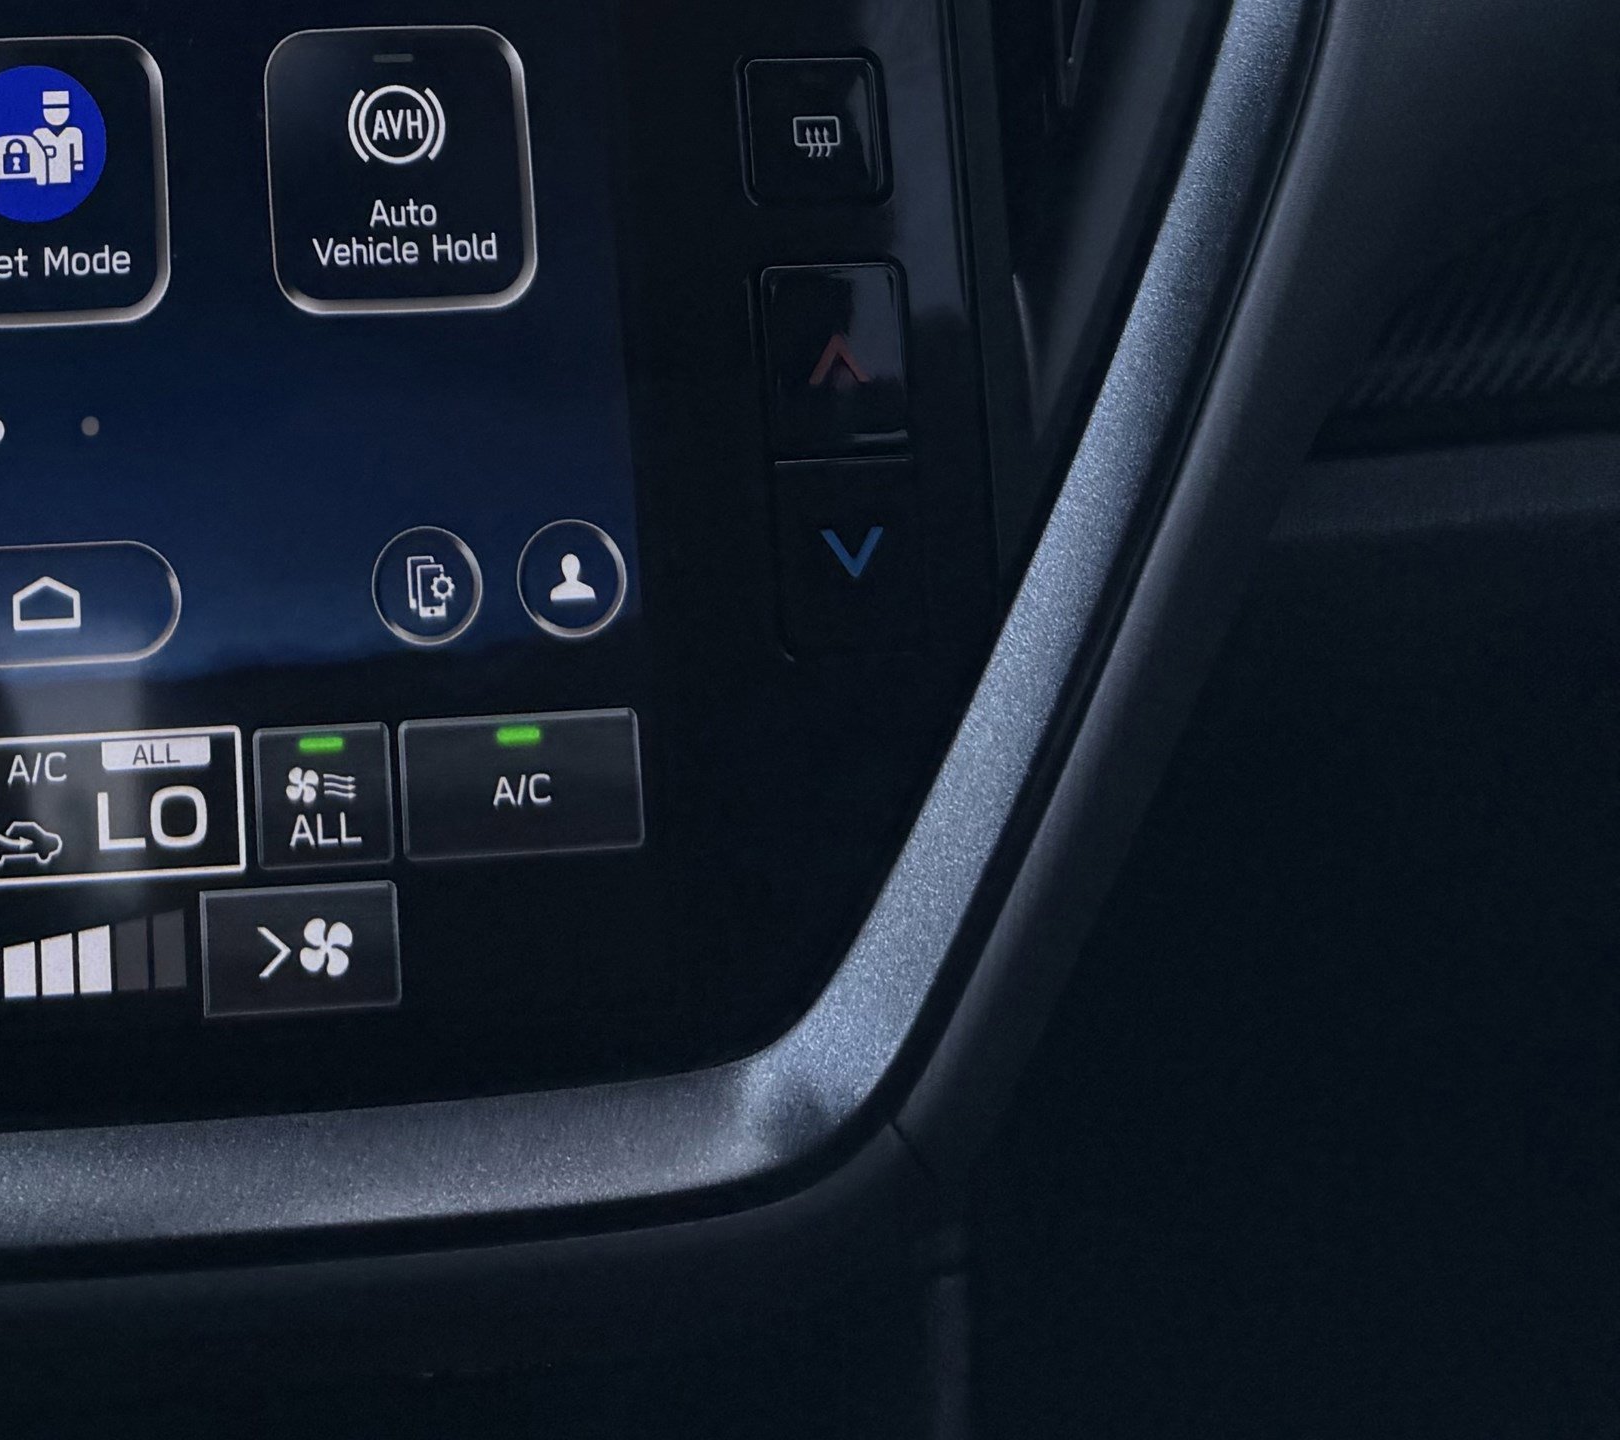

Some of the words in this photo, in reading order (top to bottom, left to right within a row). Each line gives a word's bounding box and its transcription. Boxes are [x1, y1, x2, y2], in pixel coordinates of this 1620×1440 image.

[369, 198, 438, 228] Auto
[43, 244, 131, 277] Mode
[311, 235, 419, 267] Vehicle
[432, 232, 498, 263] Hold
[7, 751, 68, 785] A/C
[131, 742, 182, 768] ALL
[492, 773, 552, 807] A/C
[96, 785, 208, 854] LO
[289, 811, 363, 848] ALL
